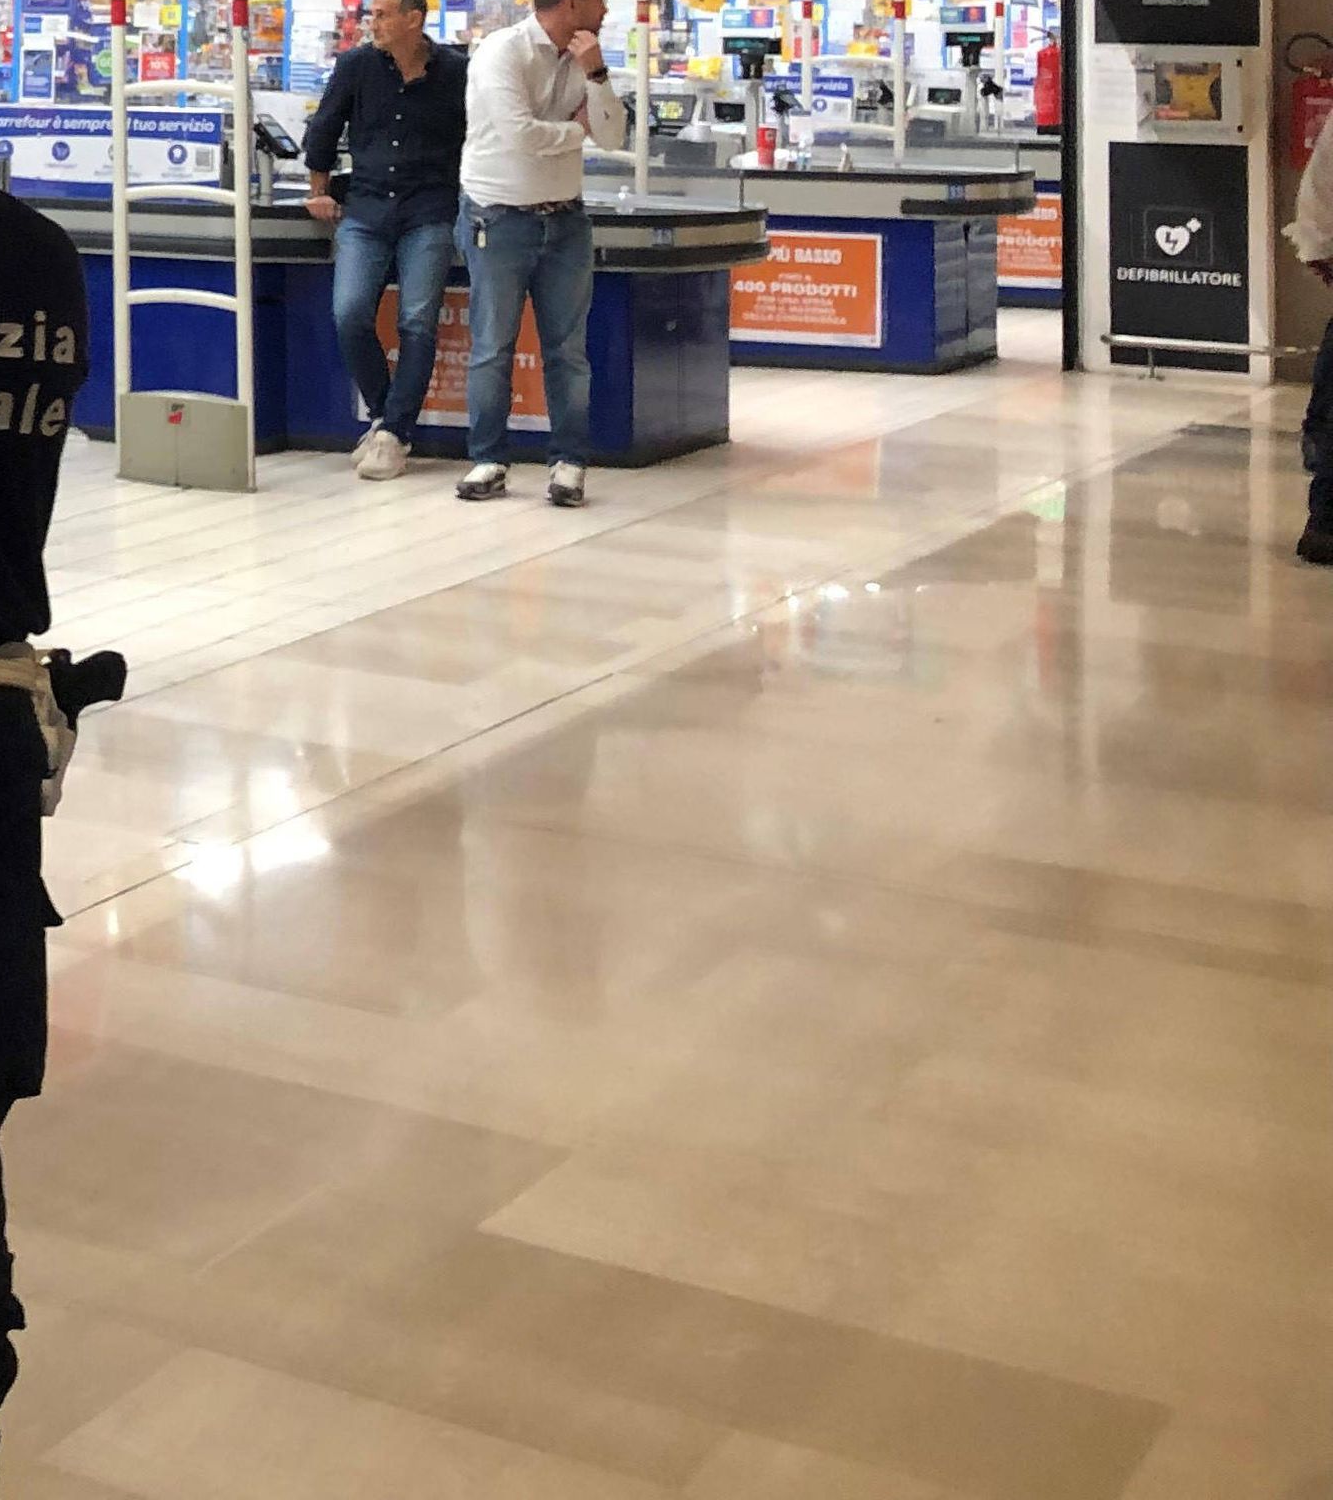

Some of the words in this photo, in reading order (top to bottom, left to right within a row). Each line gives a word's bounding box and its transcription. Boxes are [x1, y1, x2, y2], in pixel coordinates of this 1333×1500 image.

[133, 119, 156, 132] tuo
[158, 118, 215, 133] servizio
[794, 247, 842, 265] BASSO
[1116, 266, 1242, 288] DEFIBRILLATORE
[733, 280, 766, 293] 400
[770, 281, 858, 298] PRODOTTI
